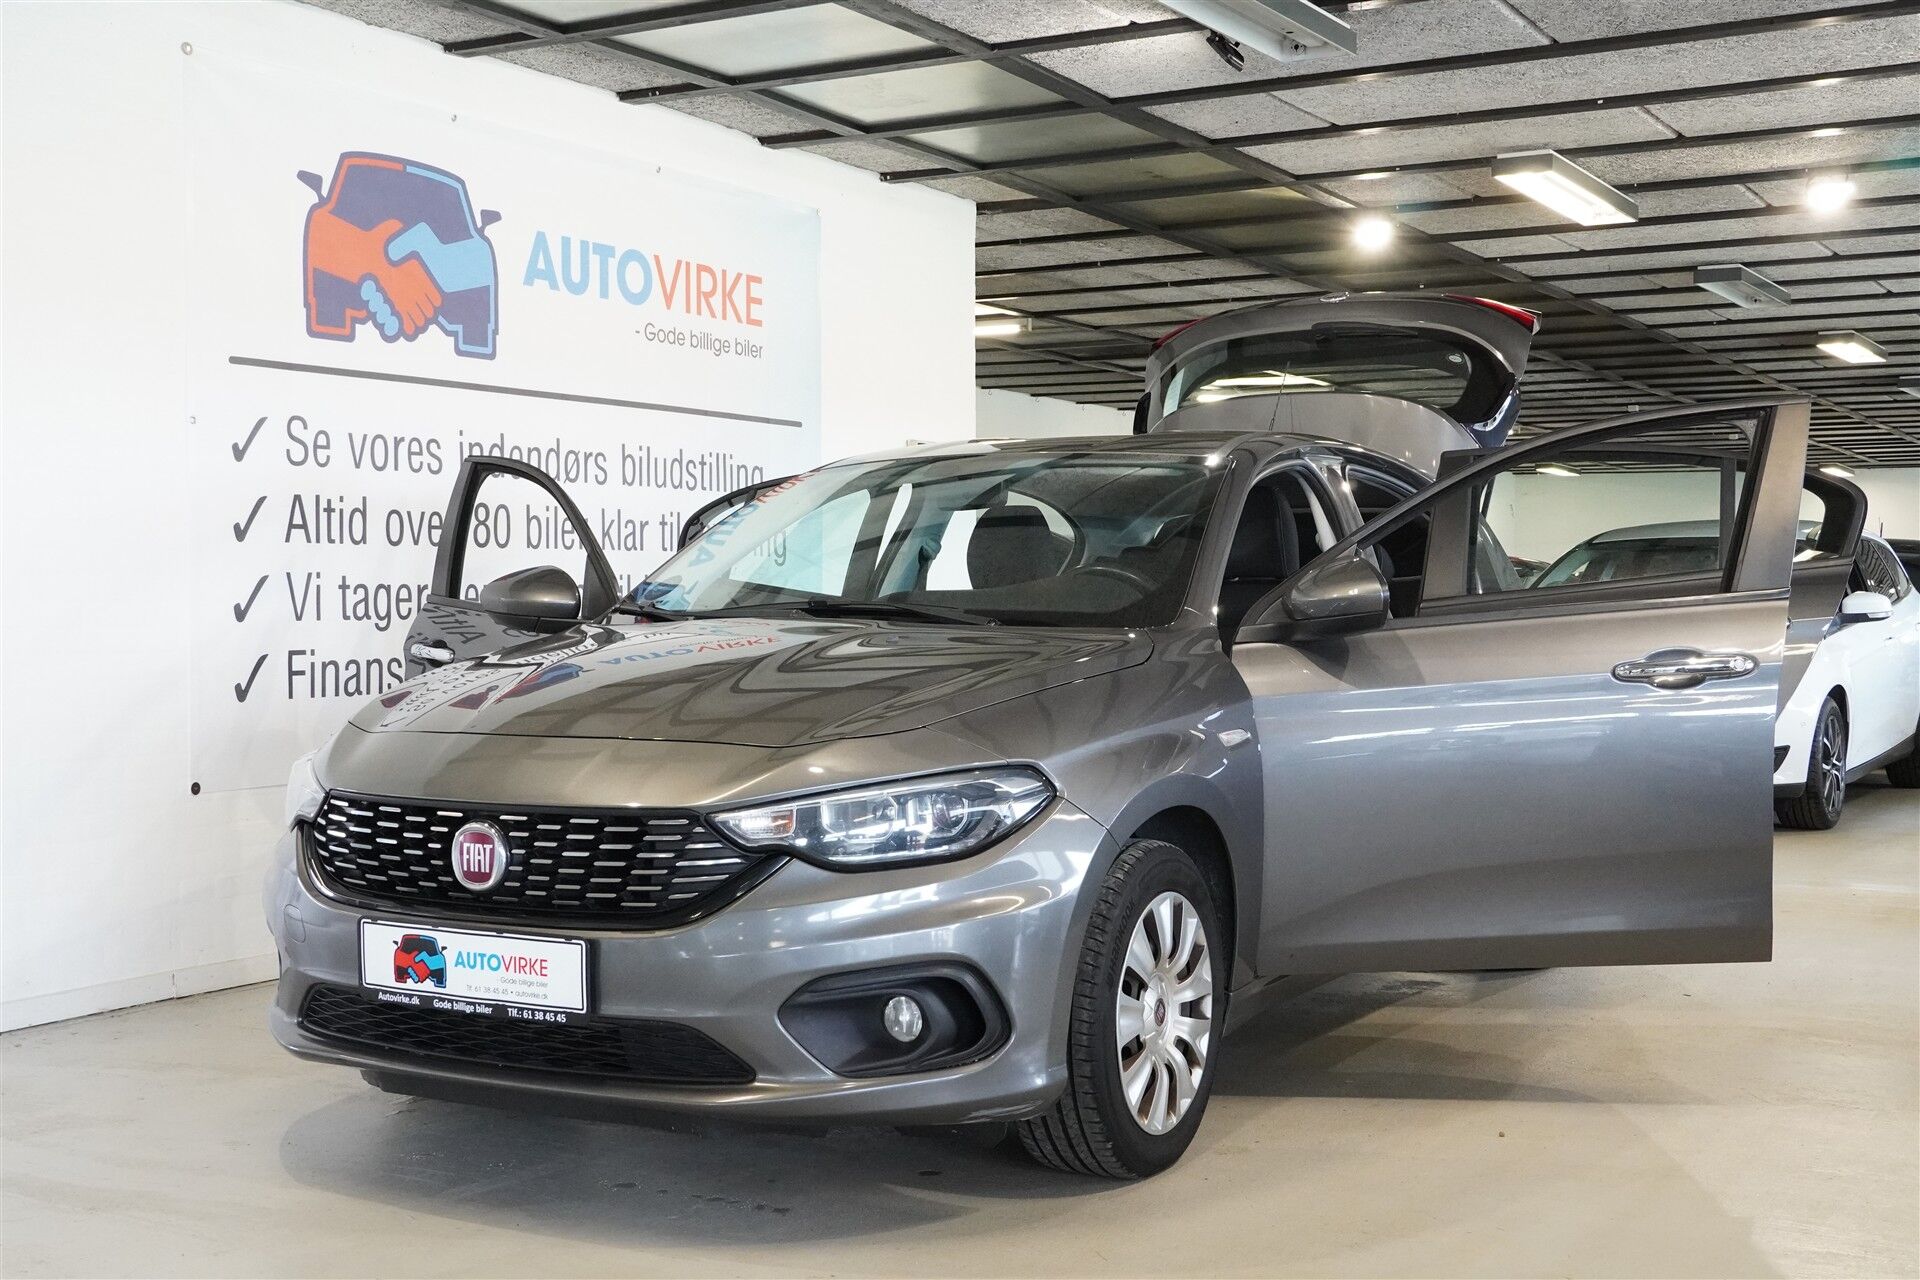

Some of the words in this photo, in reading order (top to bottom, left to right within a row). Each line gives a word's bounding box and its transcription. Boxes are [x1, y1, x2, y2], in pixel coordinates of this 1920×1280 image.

[523, 230, 763, 328] AUTOVIRKE
[644, 322, 686, 346] Gode
[690, 329, 731, 357] billige
[735, 339, 763, 359] biler
[286, 415, 331, 468] Se
[348, 432, 443, 475] vores
[285, 494, 368, 546] Altid
[385, 508, 444, 547] ove
[473, 502, 511, 549] 80
[526, 504, 588, 550] bile
[601, 508, 649, 551] klar
[659, 511, 680, 552] til
[286, 571, 321, 621] Vi
[338, 575, 429, 632] tager
[462, 842, 493, 874] FIAT
[454, 951, 549, 977] AUTOVIRKE
[378, 991, 420, 1005] Autovirke.dk
[433, 998, 452, 1010] Gode
[453, 1001, 475, 1014] billige
[475, 1003, 493, 1015] biler
[523, 1010, 533, 1019] 61
[534, 1011, 544, 1021] 38
[545, 1012, 555, 1022] 45
[556, 1013, 567, 1023] 45
